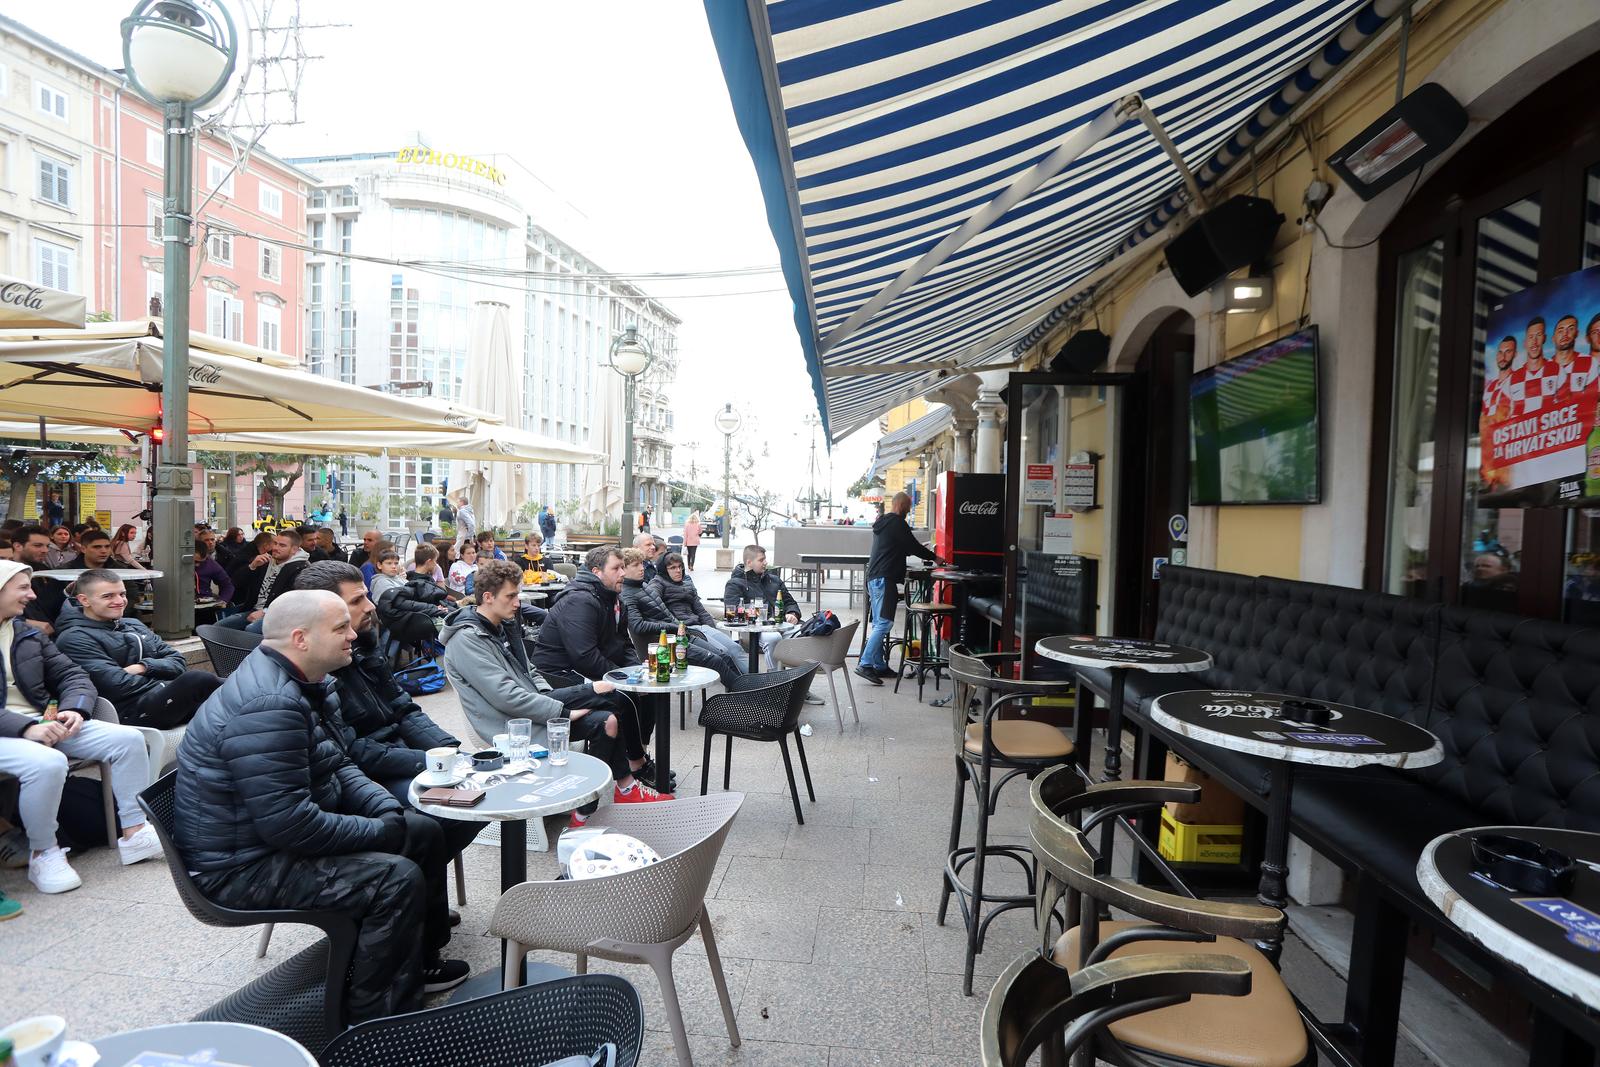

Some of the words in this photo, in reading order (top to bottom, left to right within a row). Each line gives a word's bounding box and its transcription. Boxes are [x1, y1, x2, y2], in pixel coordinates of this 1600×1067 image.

[396, 147, 507, 187] EUROHERC
[1493, 416, 1538, 445] OSTAVI
[1540, 404, 1579, 431] SRCE
[1493, 446, 1503, 459] ZA
[1504, 422, 1583, 460] HRVATSKU!
